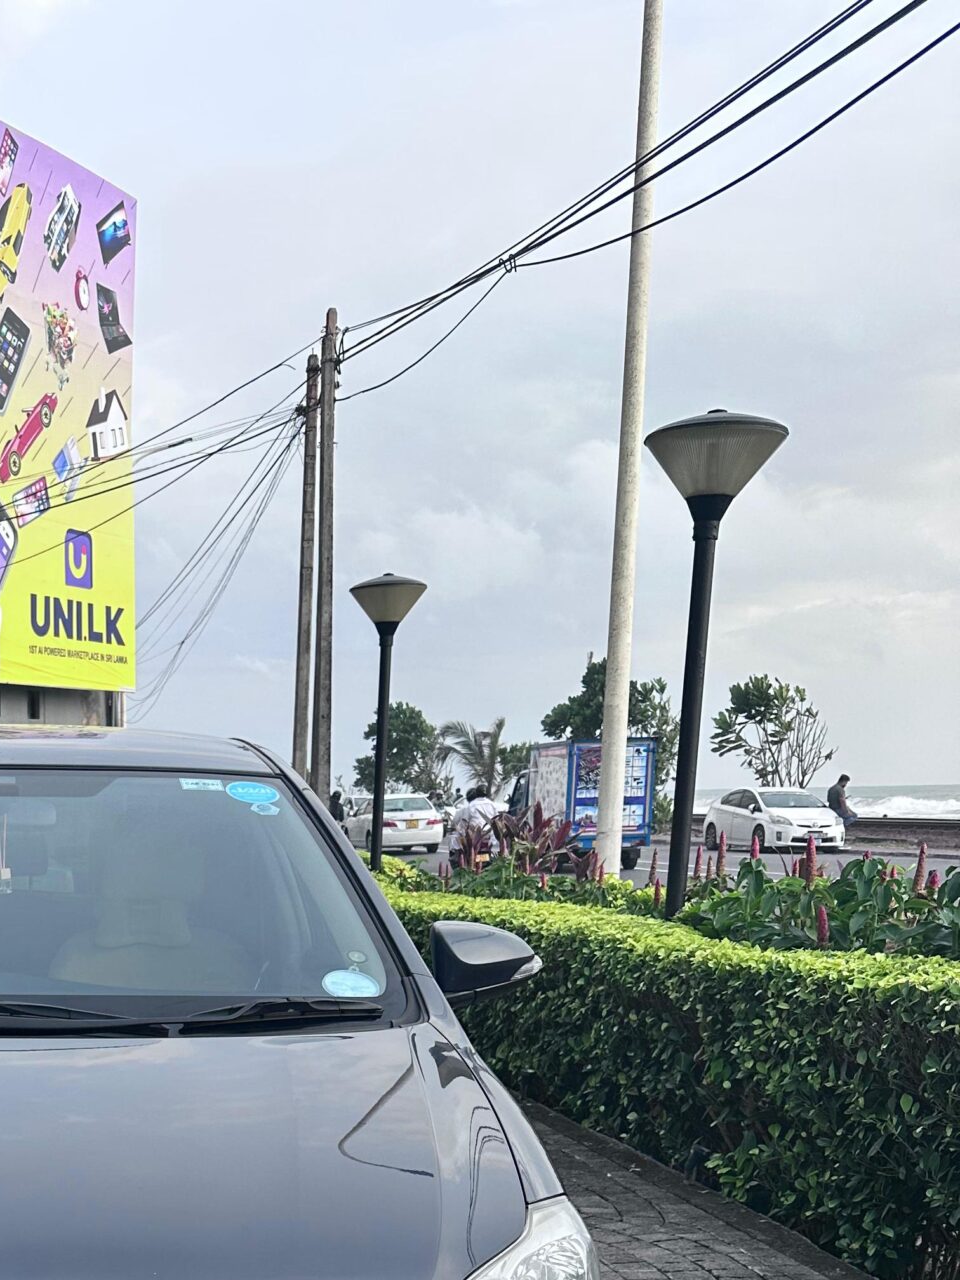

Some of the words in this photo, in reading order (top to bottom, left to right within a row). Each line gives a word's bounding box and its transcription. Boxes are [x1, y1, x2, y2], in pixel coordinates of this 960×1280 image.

[30, 593, 126, 646] UNI.LK
[44, 647, 66, 657] POWERED
[67, 650, 100, 661] MARKETPLACE
